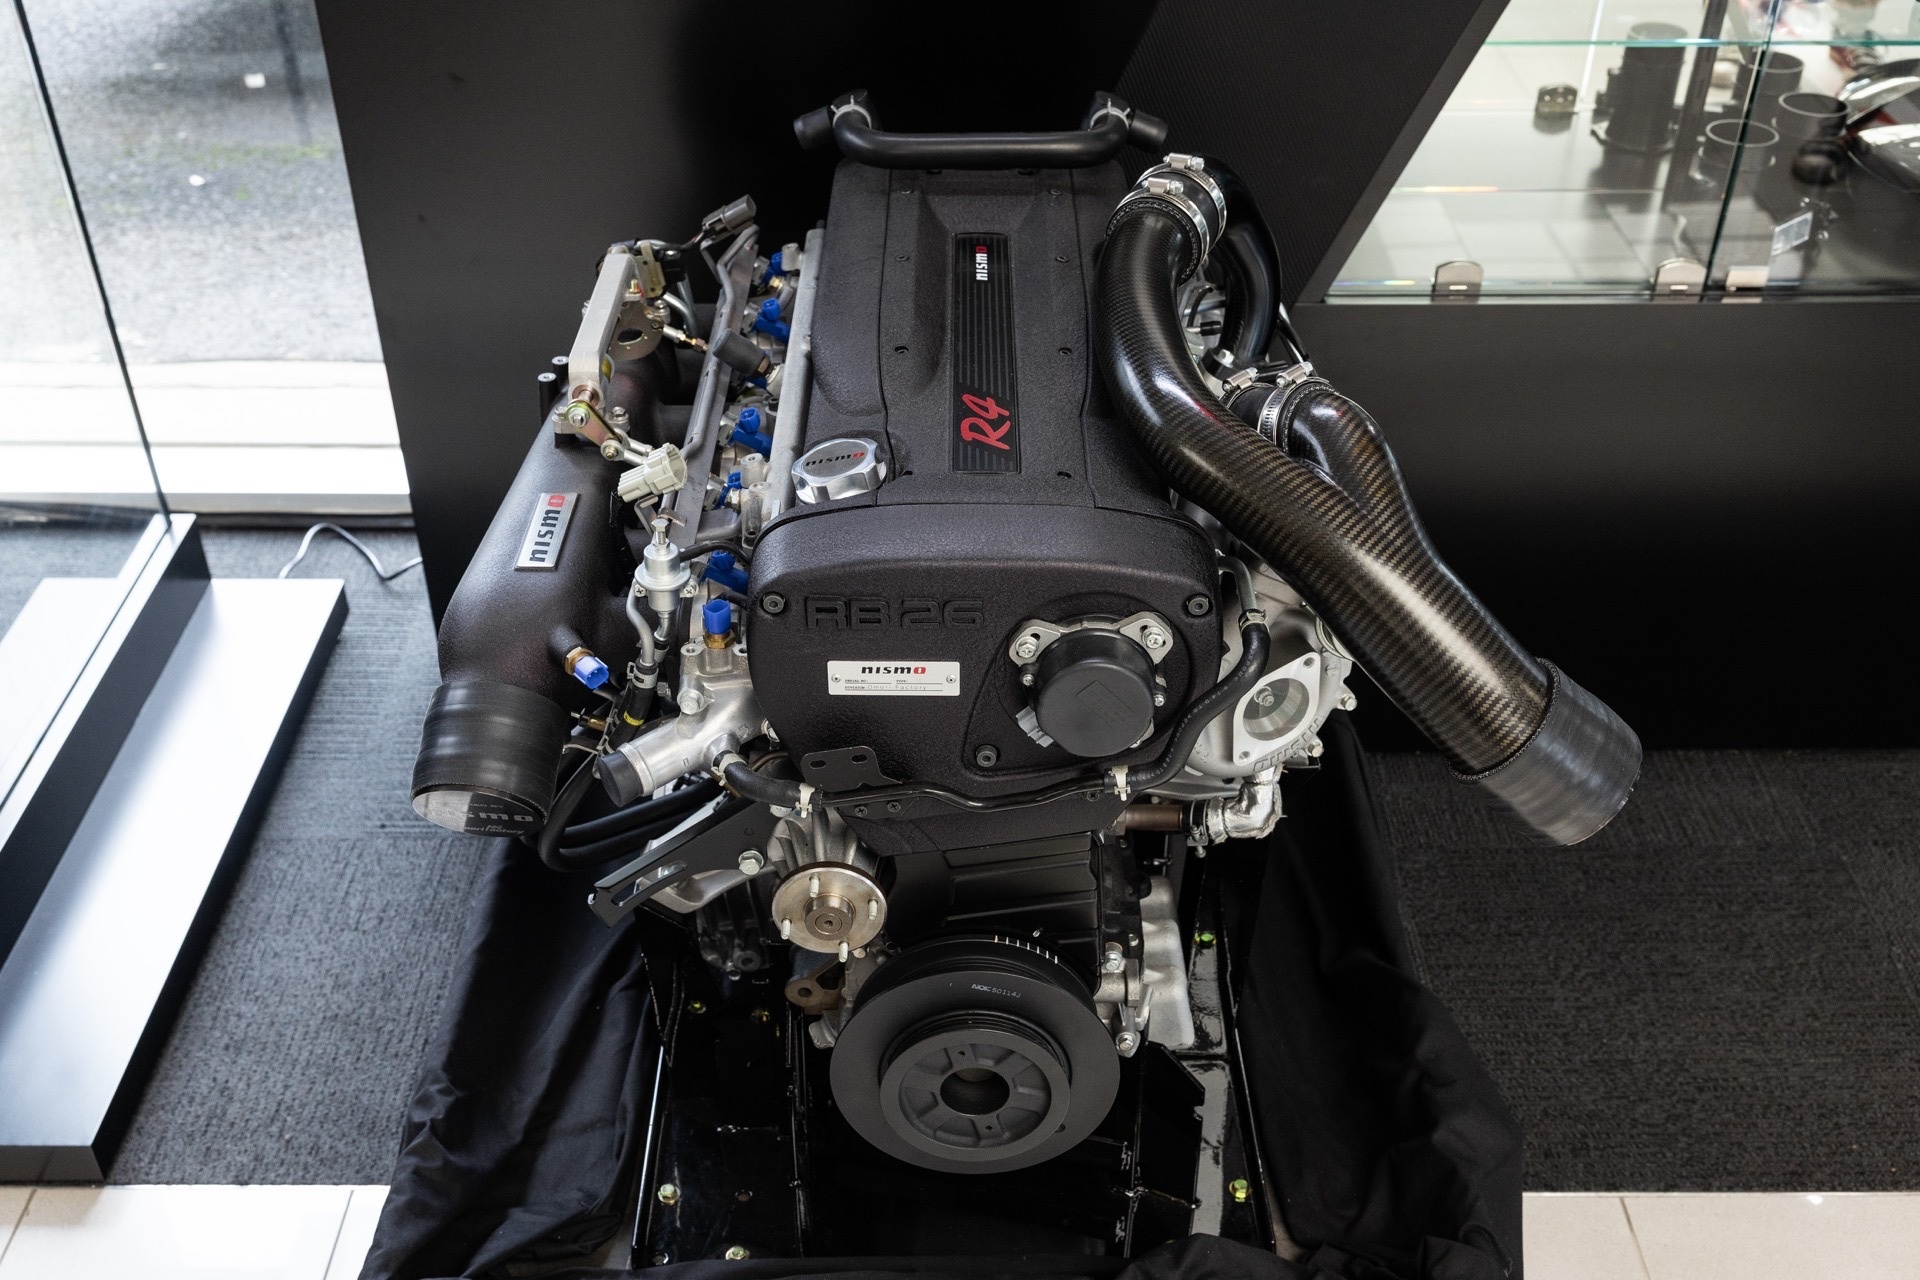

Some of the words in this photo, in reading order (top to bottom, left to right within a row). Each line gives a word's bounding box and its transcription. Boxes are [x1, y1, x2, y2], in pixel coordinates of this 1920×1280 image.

[975, 245, 989, 281] nismo
[960, 393, 1011, 450] R4
[805, 451, 865, 467] nismo
[529, 494, 566, 563] nismo
[861, 666, 927, 675] nismo
